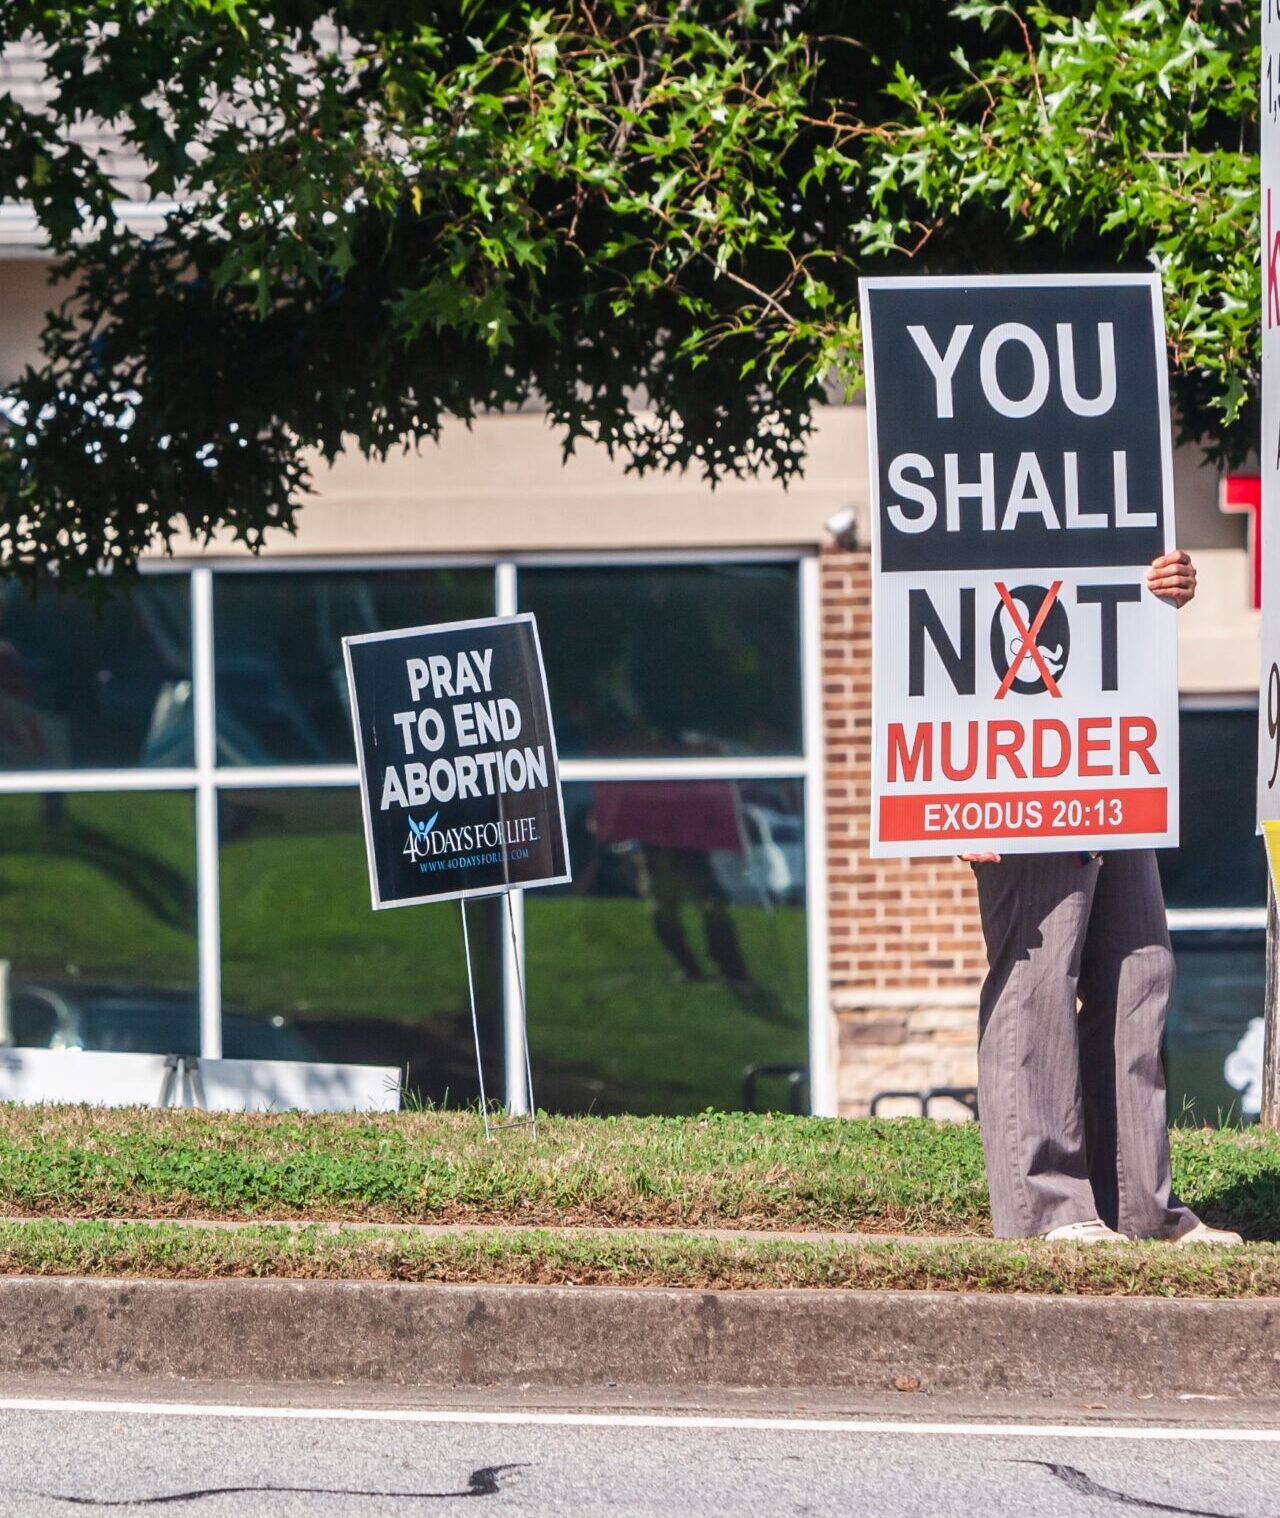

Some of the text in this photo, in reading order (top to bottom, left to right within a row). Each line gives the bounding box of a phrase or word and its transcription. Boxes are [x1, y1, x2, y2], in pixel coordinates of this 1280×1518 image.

[906, 321, 1117, 419] YOU
[886, 450, 1158, 534] SHALL
[406, 648, 493, 702] PRAY
[393, 697, 522, 755] TO END
[886, 715, 1161, 783] MURDER
[380, 745, 549, 811] ABORTION
[923, 798, 1123, 832] EXODUS 20:13
